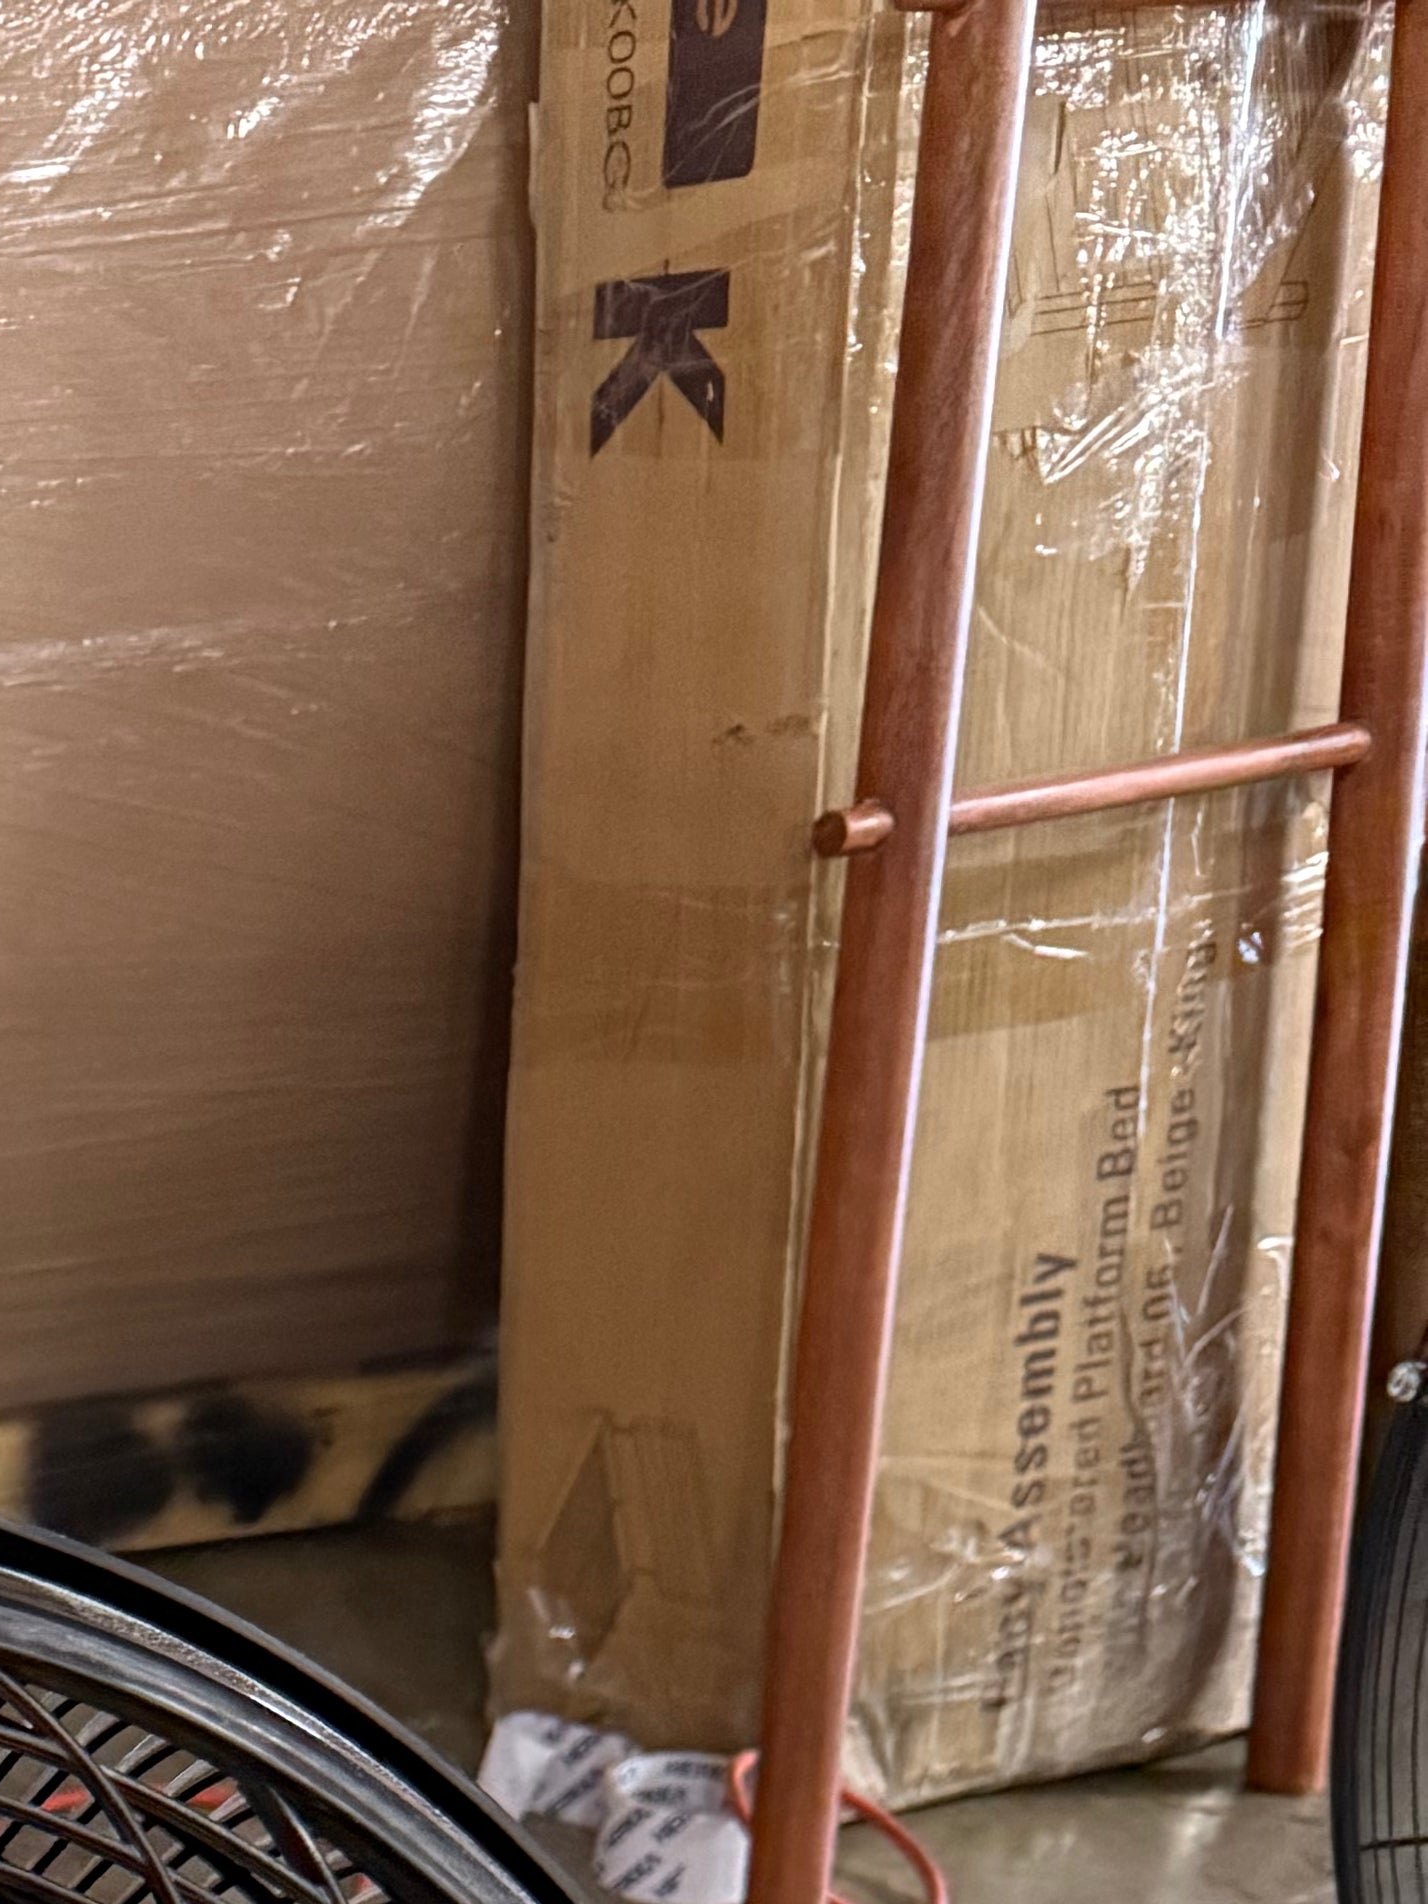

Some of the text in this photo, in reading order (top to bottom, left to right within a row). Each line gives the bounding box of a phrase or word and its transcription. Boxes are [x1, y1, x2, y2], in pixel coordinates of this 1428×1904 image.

[590, 268, 731, 459] K
[1096, 1085, 1140, 1181] Bed
[1150, 1087, 1199, 1231] Beige
[1072, 1196, 1129, 1403] Platform
[999, 1252, 1078, 1549] Assembly
